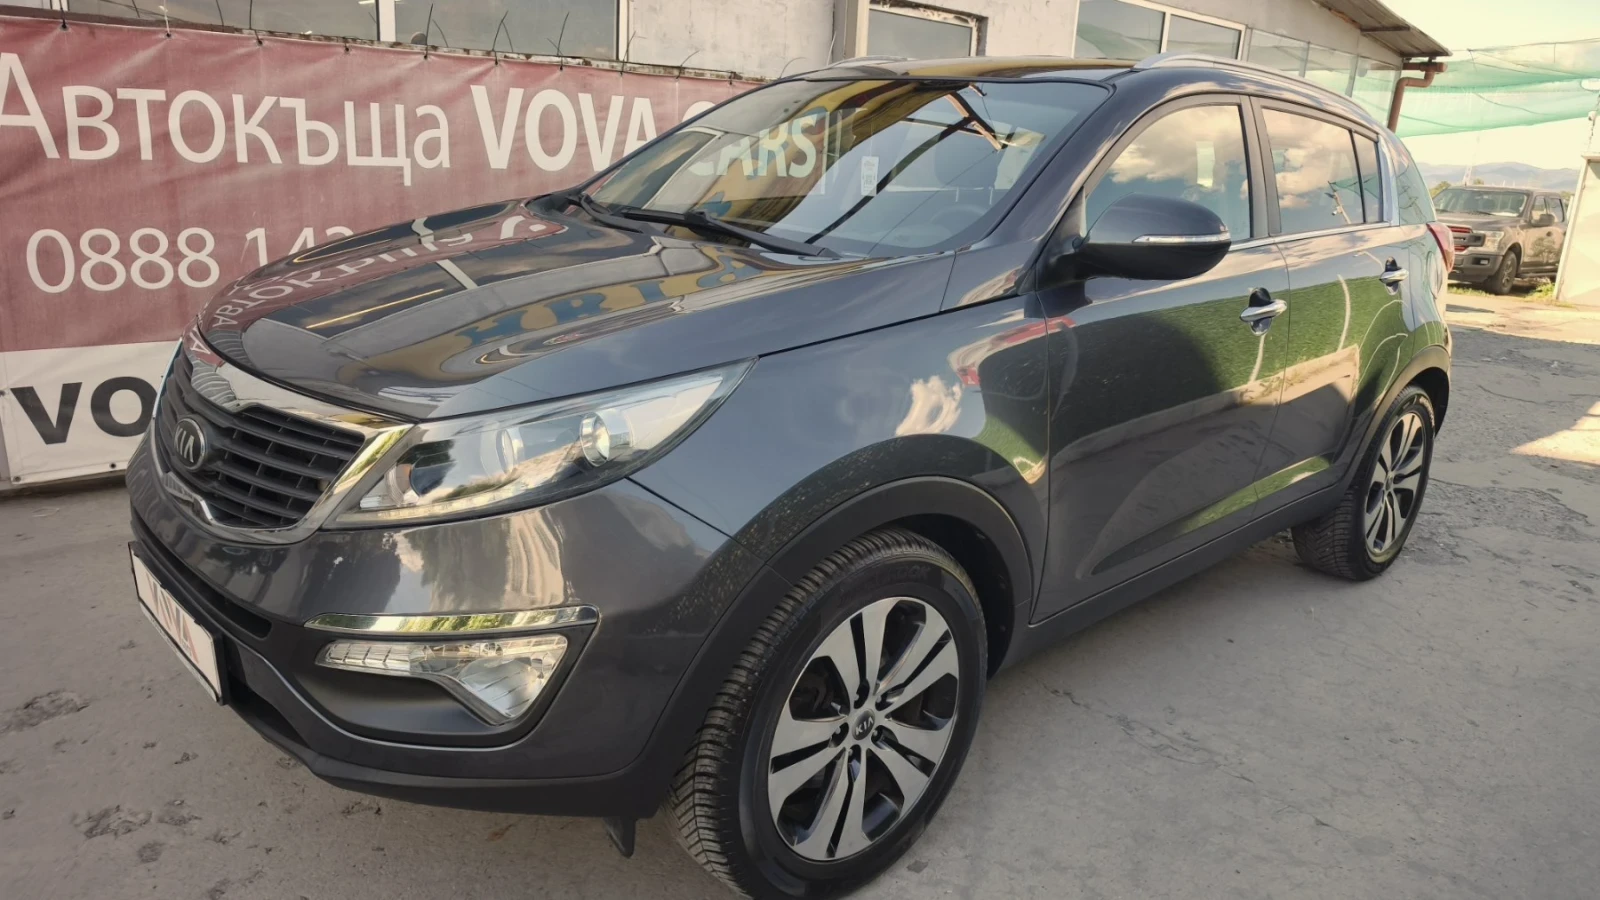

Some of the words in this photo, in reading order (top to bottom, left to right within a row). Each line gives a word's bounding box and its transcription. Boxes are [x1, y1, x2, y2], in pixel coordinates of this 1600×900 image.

[470, 85, 657, 172] VOVA
[26, 227, 220, 293] 0888
[174, 425, 195, 463] KIA
[855, 716, 874, 736] KIA
